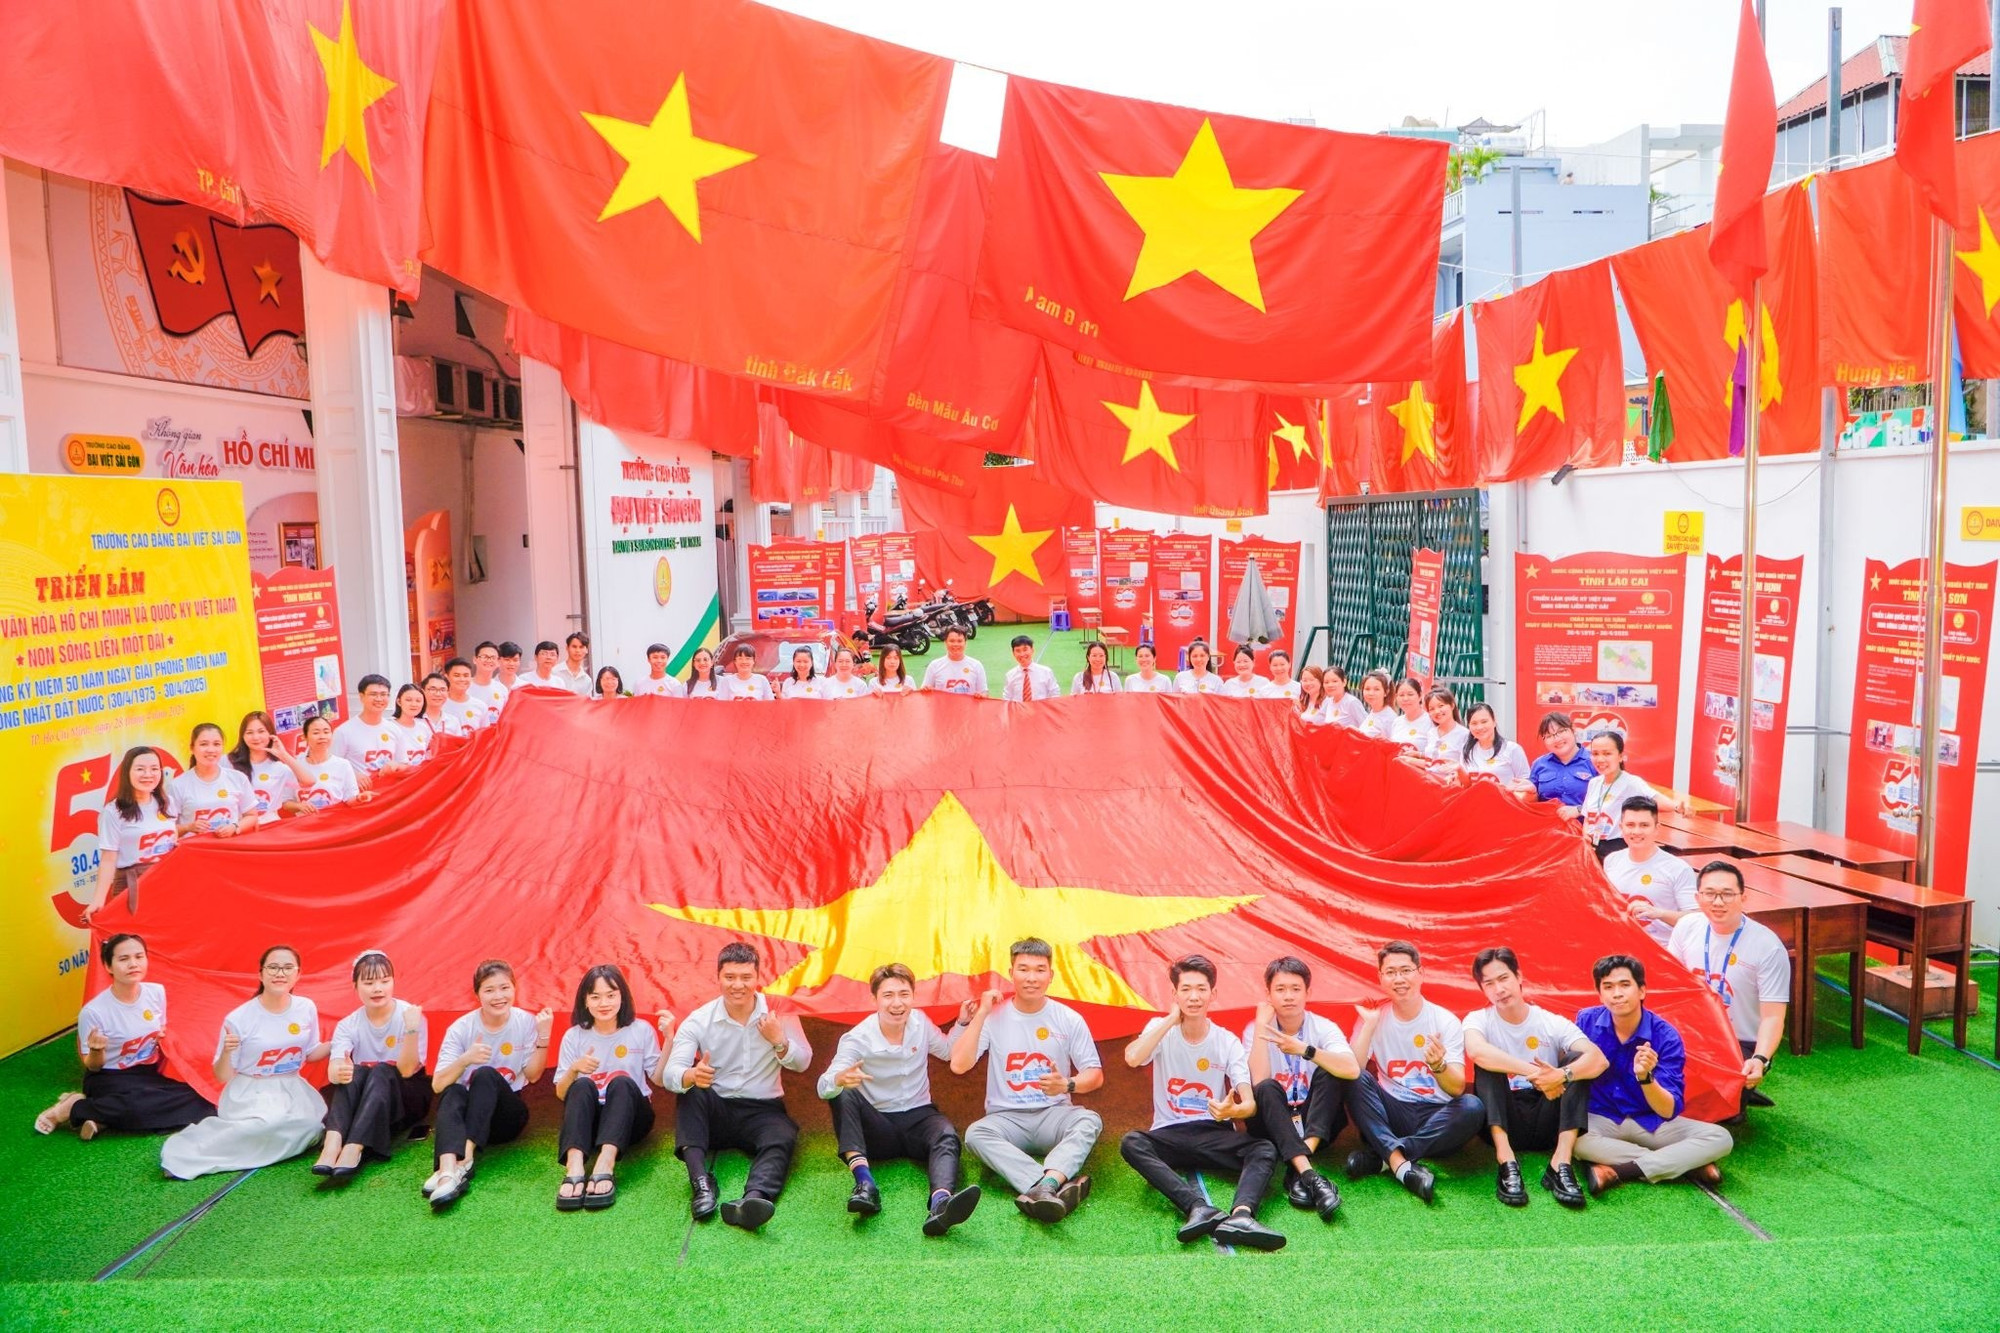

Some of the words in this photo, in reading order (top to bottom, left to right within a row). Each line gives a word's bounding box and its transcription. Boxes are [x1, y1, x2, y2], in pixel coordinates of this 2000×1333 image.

[164, 450, 195, 478] Văn
[198, 454, 219, 476] hóa
[223, 430, 254, 465] HỒ
[259, 438, 289, 467] CHÍ
[295, 447, 315, 470] MI
[91, 531, 129, 550] TRƯỜNG
[132, 533, 148, 548] CAO
[151, 529, 175, 548] ĐẲNG
[177, 532, 190, 549] ĐẠI
[193, 529, 209, 547] VIỆT
[211, 530, 224, 545] SÀI
[226, 529, 242, 545] GÒN
[35, 564, 101, 603] TRIỂN
[106, 567, 146, 598] LÃM
[1579, 575, 1605, 586] TỈNH
[1631, 577, 1649, 587] CAI
[1, 614, 27, 640] VĂN
[31, 610, 57, 635] HÓA
[60, 606, 76, 631] HỒ
[80, 606, 99, 630] CHÍ
[102, 605, 131, 627] MINH
[134, 603, 148, 624] VÀ
[151, 601, 177, 622] QUỐC
[179, 601, 192, 620] KỲ
[194, 597, 214, 620] VIỆT
[216, 597, 237, 615] NAM
[28, 647, 56, 667] NON
[59, 641, 92, 664] SÔNG
[94, 635, 120, 659] LIỀN
[122, 633, 145, 657] MỘT
[147, 629, 165, 650] DẢI
[0, 685, 15, 703] NG
[35, 676, 63, 699] NIỆM
[66, 675, 79, 692] 50
[81, 670, 105, 690] NĂM
[107, 665, 132, 685] NGÀY
[134, 661, 153, 680] GIẢI
[155, 657, 185, 677] PHÓNG
[186, 652, 207, 672] MIỀN
[209, 652, 228, 668] NAM
[23, 702, 52, 725] NHẤT
[55, 698, 74, 719] ĐẤT
[77, 694, 105, 714] NƯỚC
[108, 684, 156, 710] (30/4/1975
[164, 677, 207, 697] 30/4/2025)
[71, 849, 100, 876] 30.4
[58, 958, 70, 976] 50
